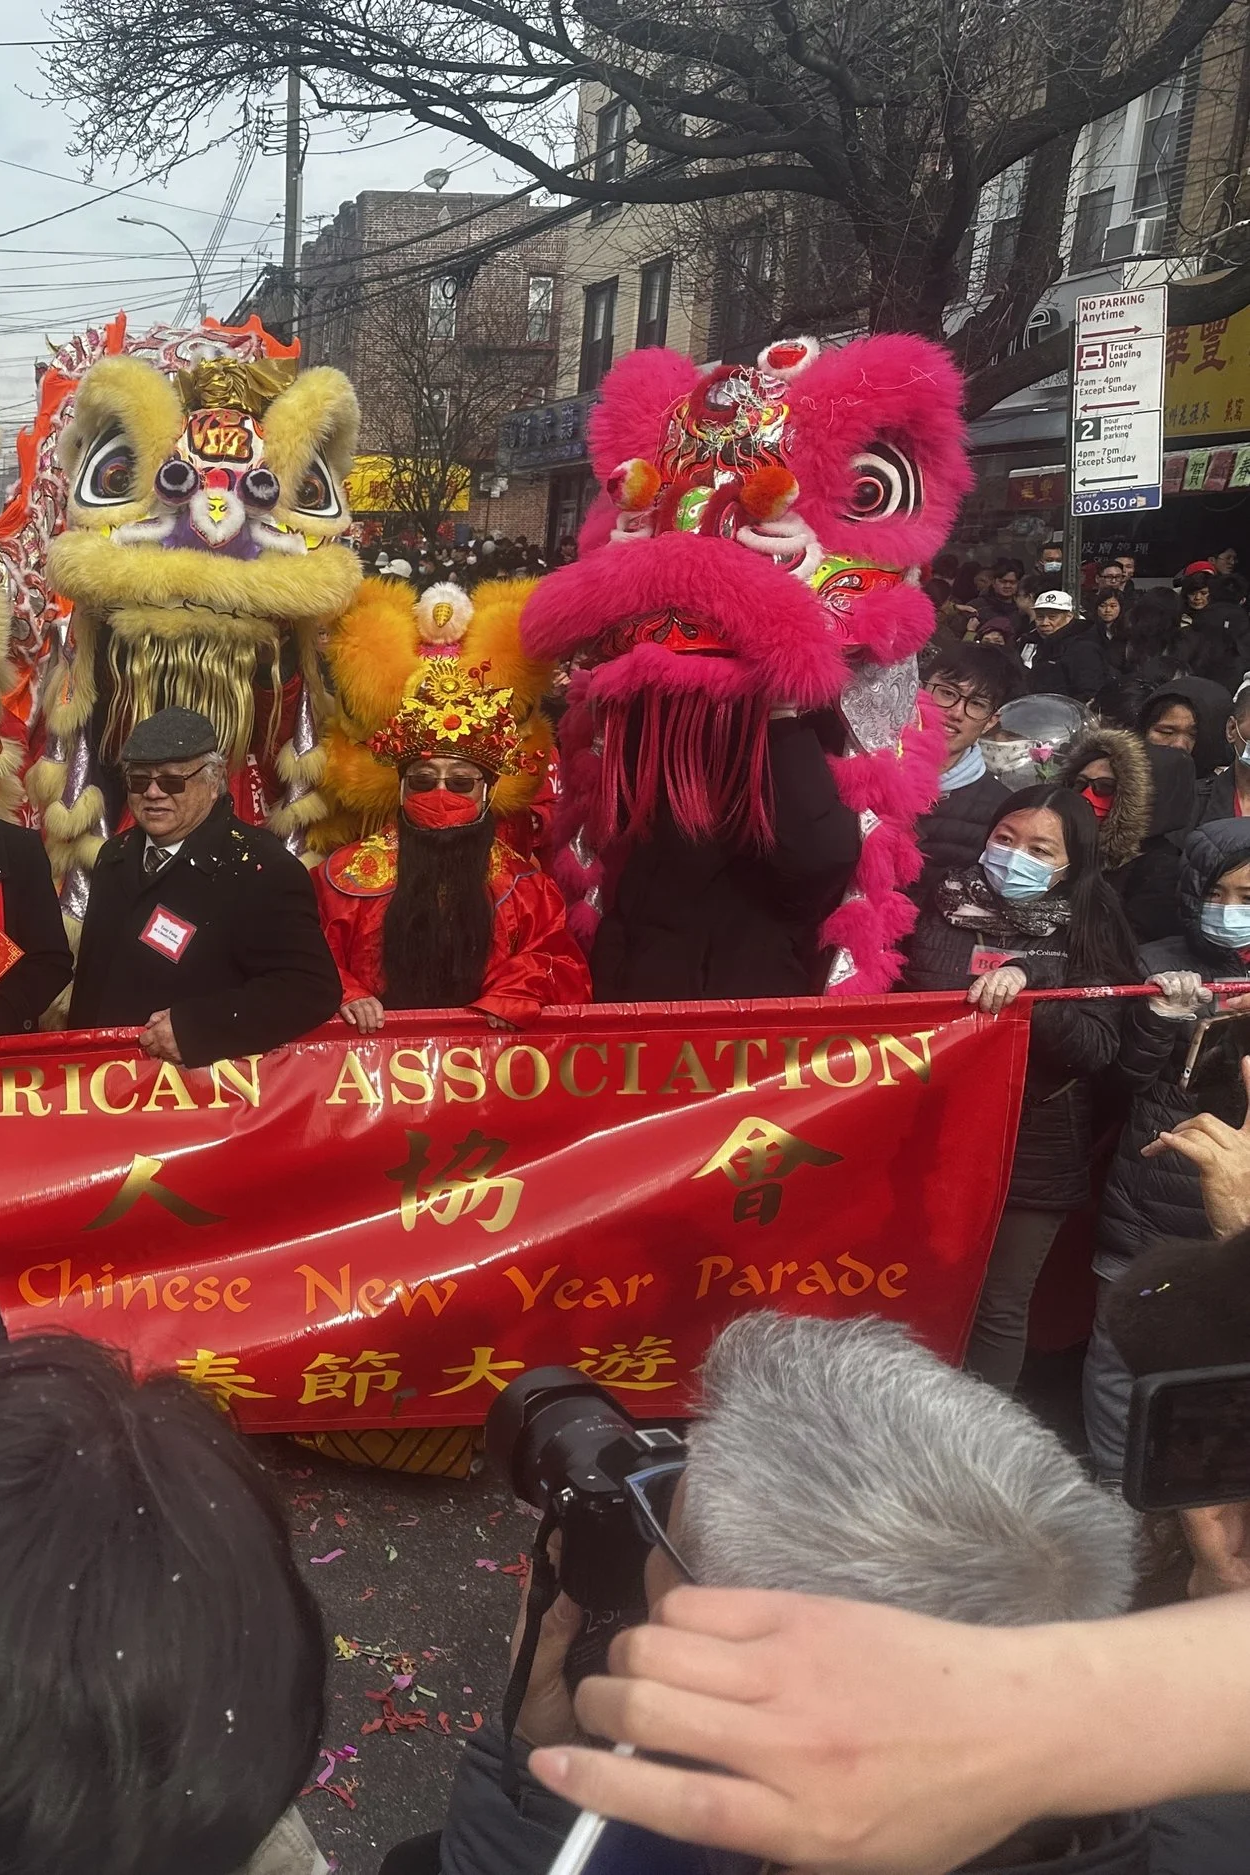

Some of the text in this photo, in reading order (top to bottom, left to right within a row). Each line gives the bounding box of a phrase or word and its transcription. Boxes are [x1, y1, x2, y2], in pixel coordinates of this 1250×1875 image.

[1081, 294, 1145, 312] NO PARKING
[1081, 310, 1125, 323] Anytime
[1110, 342, 1133, 352] Truck
[1109, 350, 1141, 360] Loading
[1108, 360, 1127, 369] Only
[1079, 378, 1096, 387] 7am
[1103, 376, 1121, 385] 4pm
[1079, 384, 1137, 396] Except Sunday
[1081, 420, 1094, 440] 2
[1103, 423, 1133, 432] metered
[1103, 431, 1129, 441] parking
[1077, 450, 1095, 459] 4pm
[1102, 447, 1120, 456] 7pm
[1077, 455, 1137, 467] Except Sunday
[1075, 497, 1127, 513] 306350
[978, 959, 1001, 970] BC
[324, 1030, 936, 1107] ASSOCIATION
[17, 1257, 253, 1313] Chinese
[293, 1263, 459, 1318] New
[502, 1263, 655, 1313] Year
[694, 1250, 909, 1300] Parade
